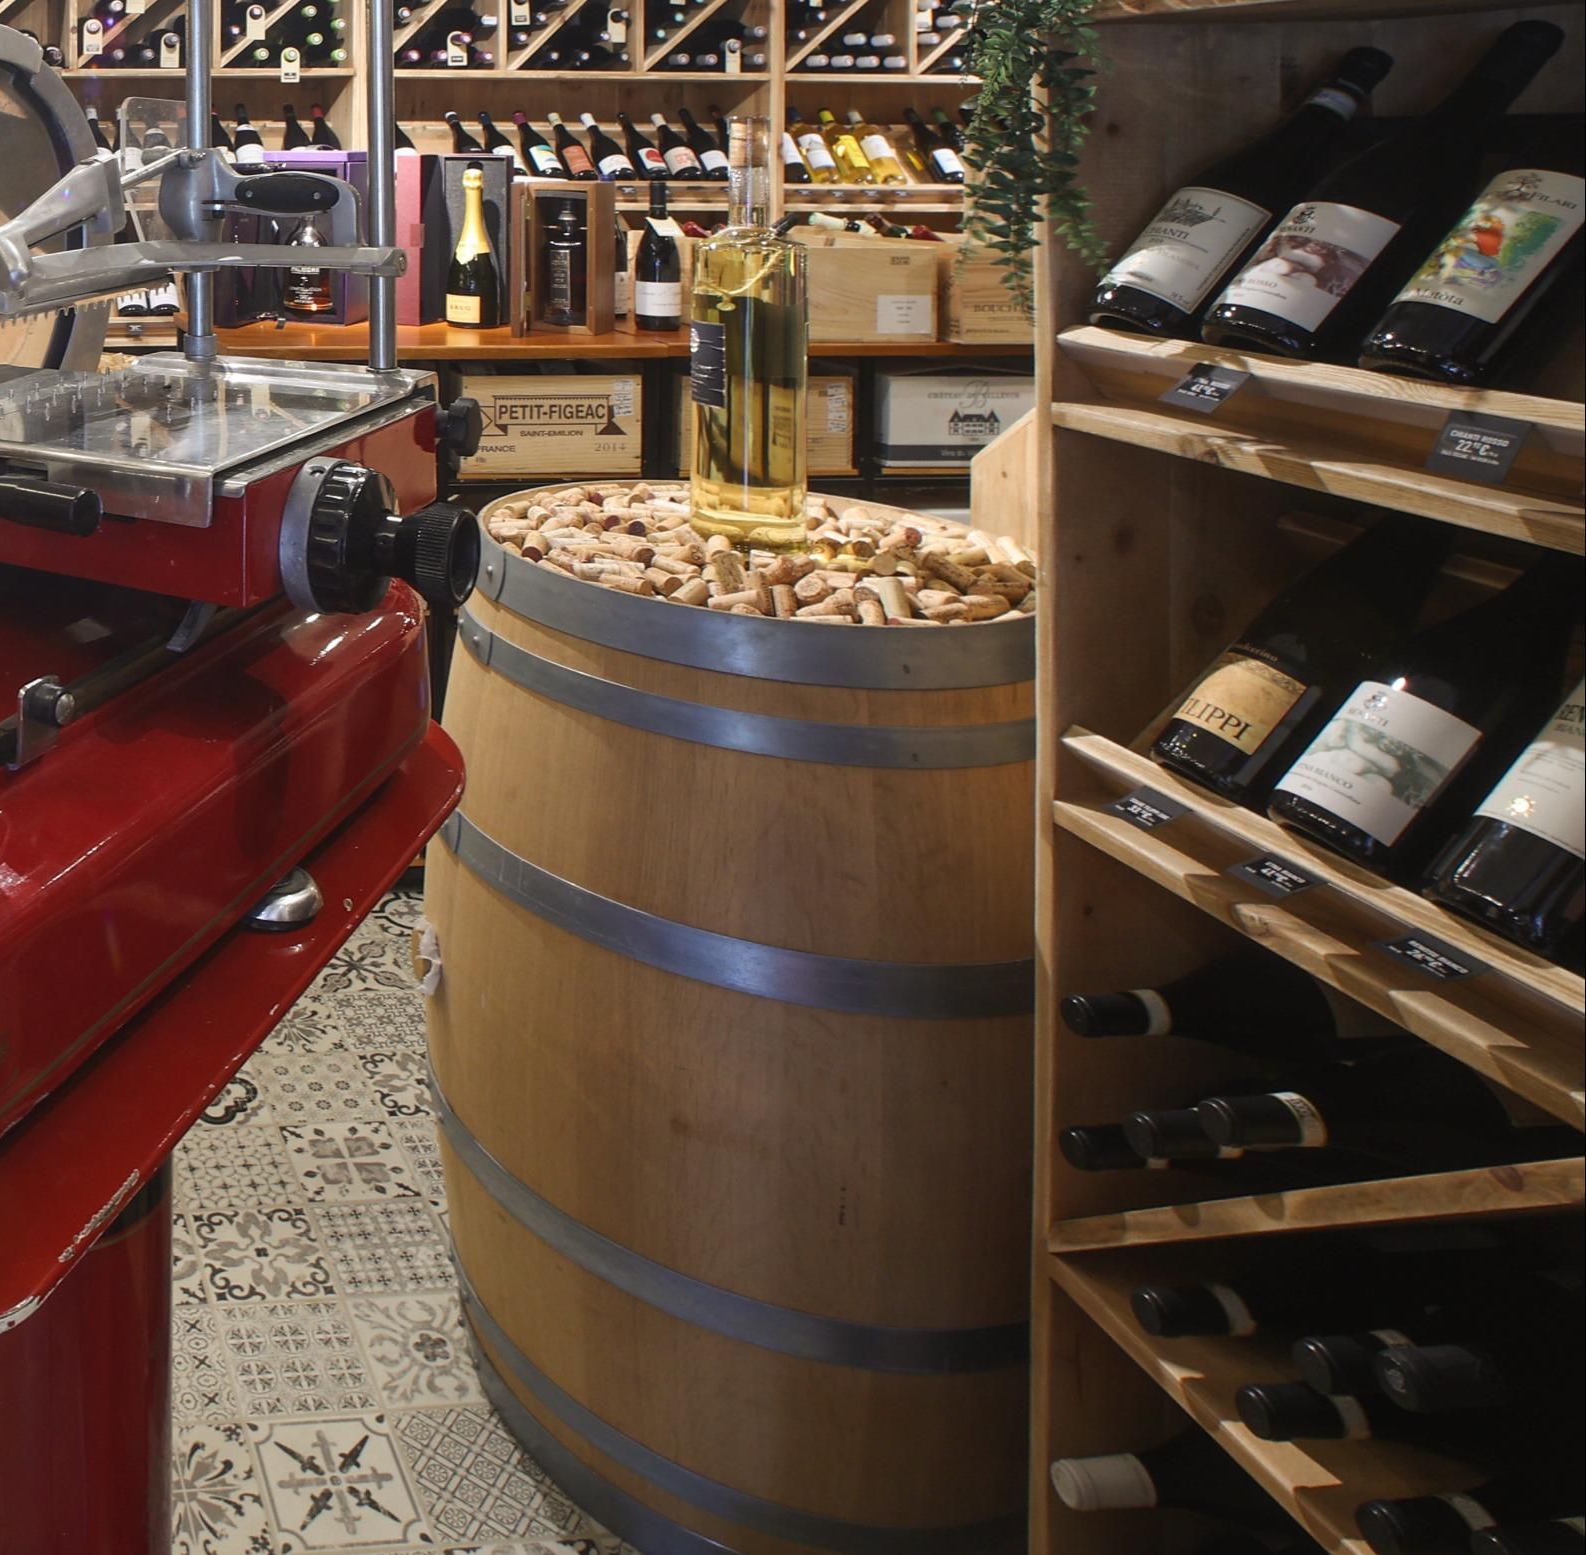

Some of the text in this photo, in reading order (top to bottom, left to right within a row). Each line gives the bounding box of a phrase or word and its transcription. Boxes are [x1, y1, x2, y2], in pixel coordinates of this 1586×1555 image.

[498, 403, 606, 421] PETIT-FIGEAC
[477, 442, 627, 453] FRANCE 2014
